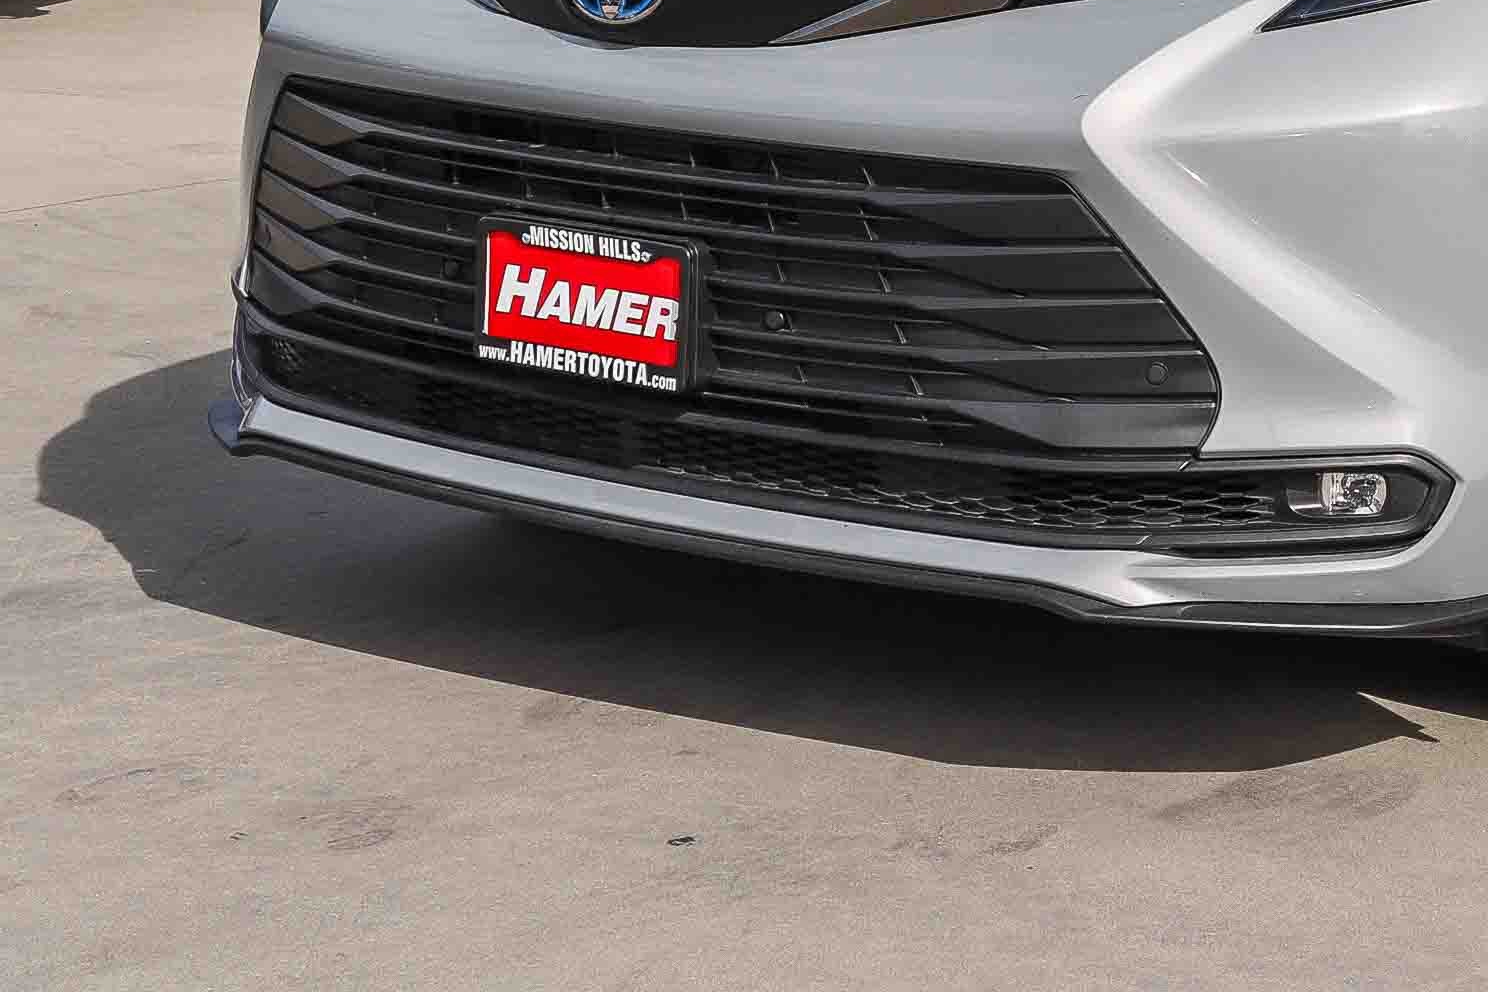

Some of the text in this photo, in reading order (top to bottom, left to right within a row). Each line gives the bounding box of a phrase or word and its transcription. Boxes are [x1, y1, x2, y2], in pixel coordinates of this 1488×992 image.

[529, 225, 641, 263] MISSION HILLS
[495, 263, 680, 341] HAMER
[478, 340, 677, 392] www.HAMERTOYOTA.com
